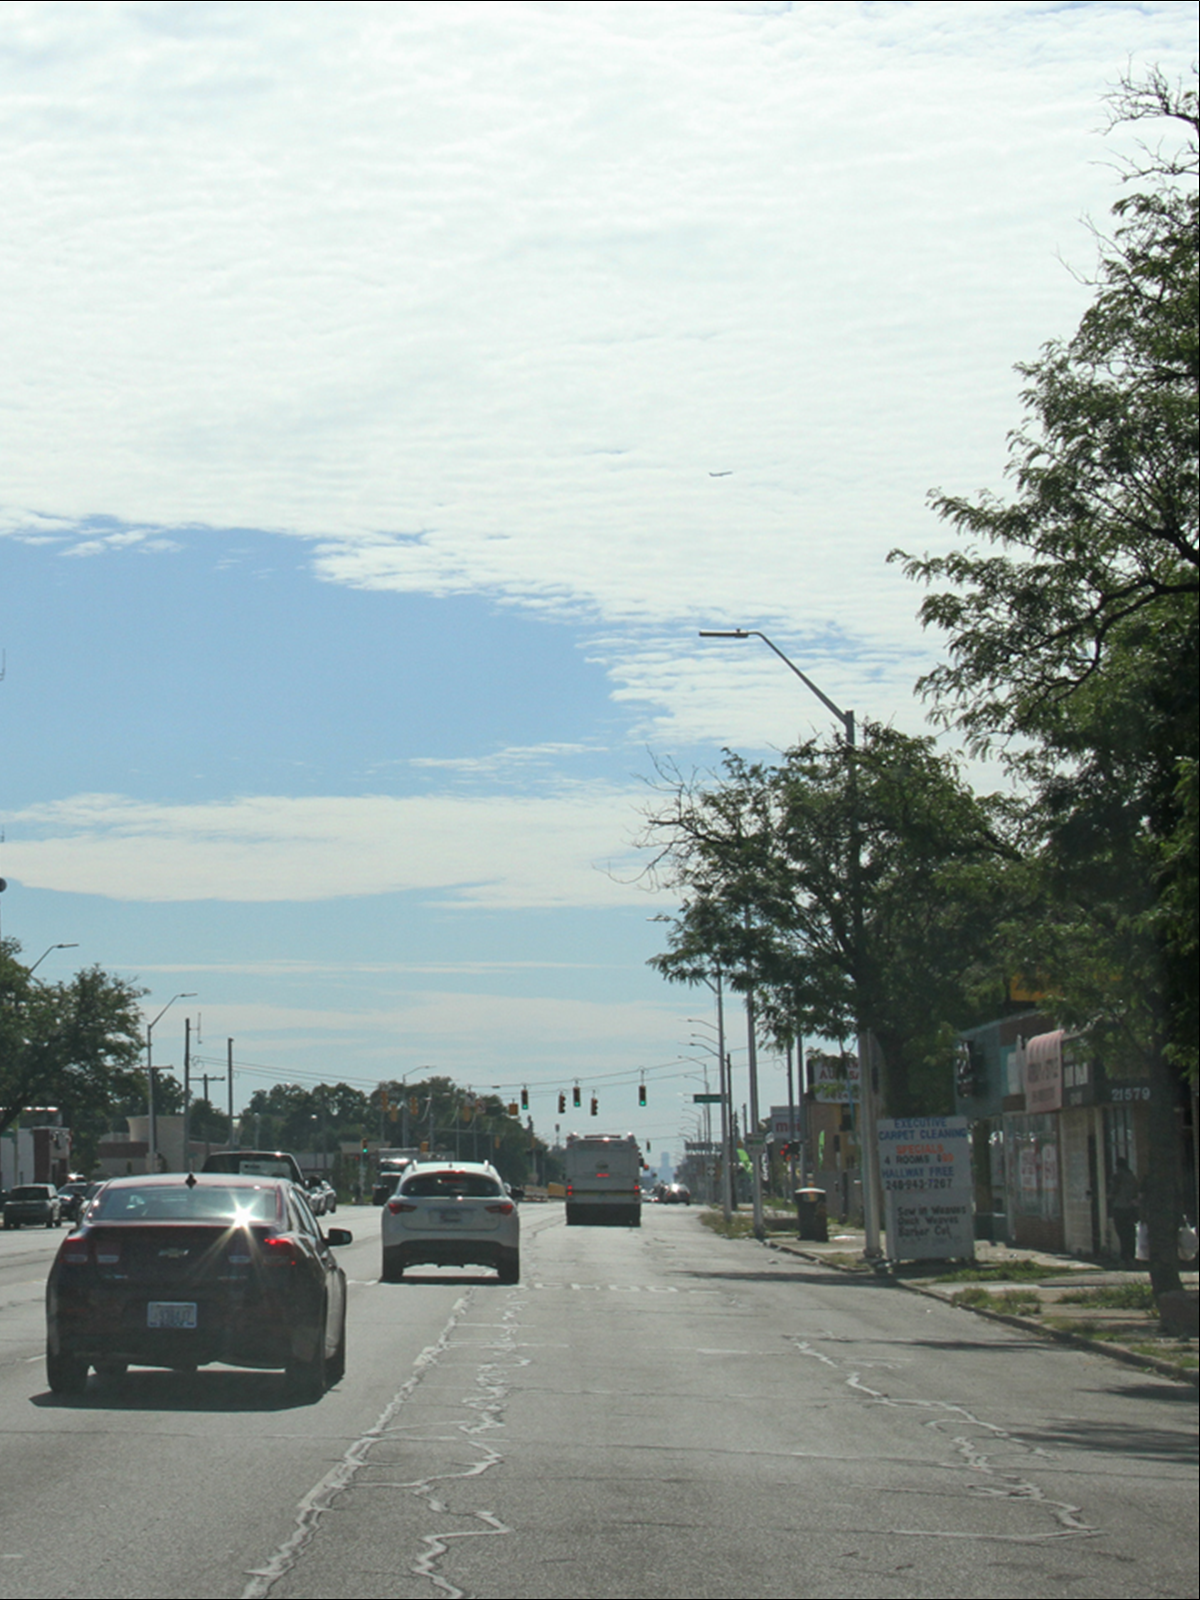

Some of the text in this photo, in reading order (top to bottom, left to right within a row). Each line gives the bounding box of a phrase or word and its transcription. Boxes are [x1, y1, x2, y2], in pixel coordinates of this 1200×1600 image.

[1111, 1087, 1151, 1101] 21579
[894, 1118, 947, 1129] EXECUTIVE
[878, 1128, 968, 1141] CARPET CLEANING
[895, 1144, 944, 1154] SPECIALS
[884, 1156, 890, 1165] 4
[896, 1155, 930, 1165] ROOMS
[881, 1166, 955, 1178] HALLWAY FREE
